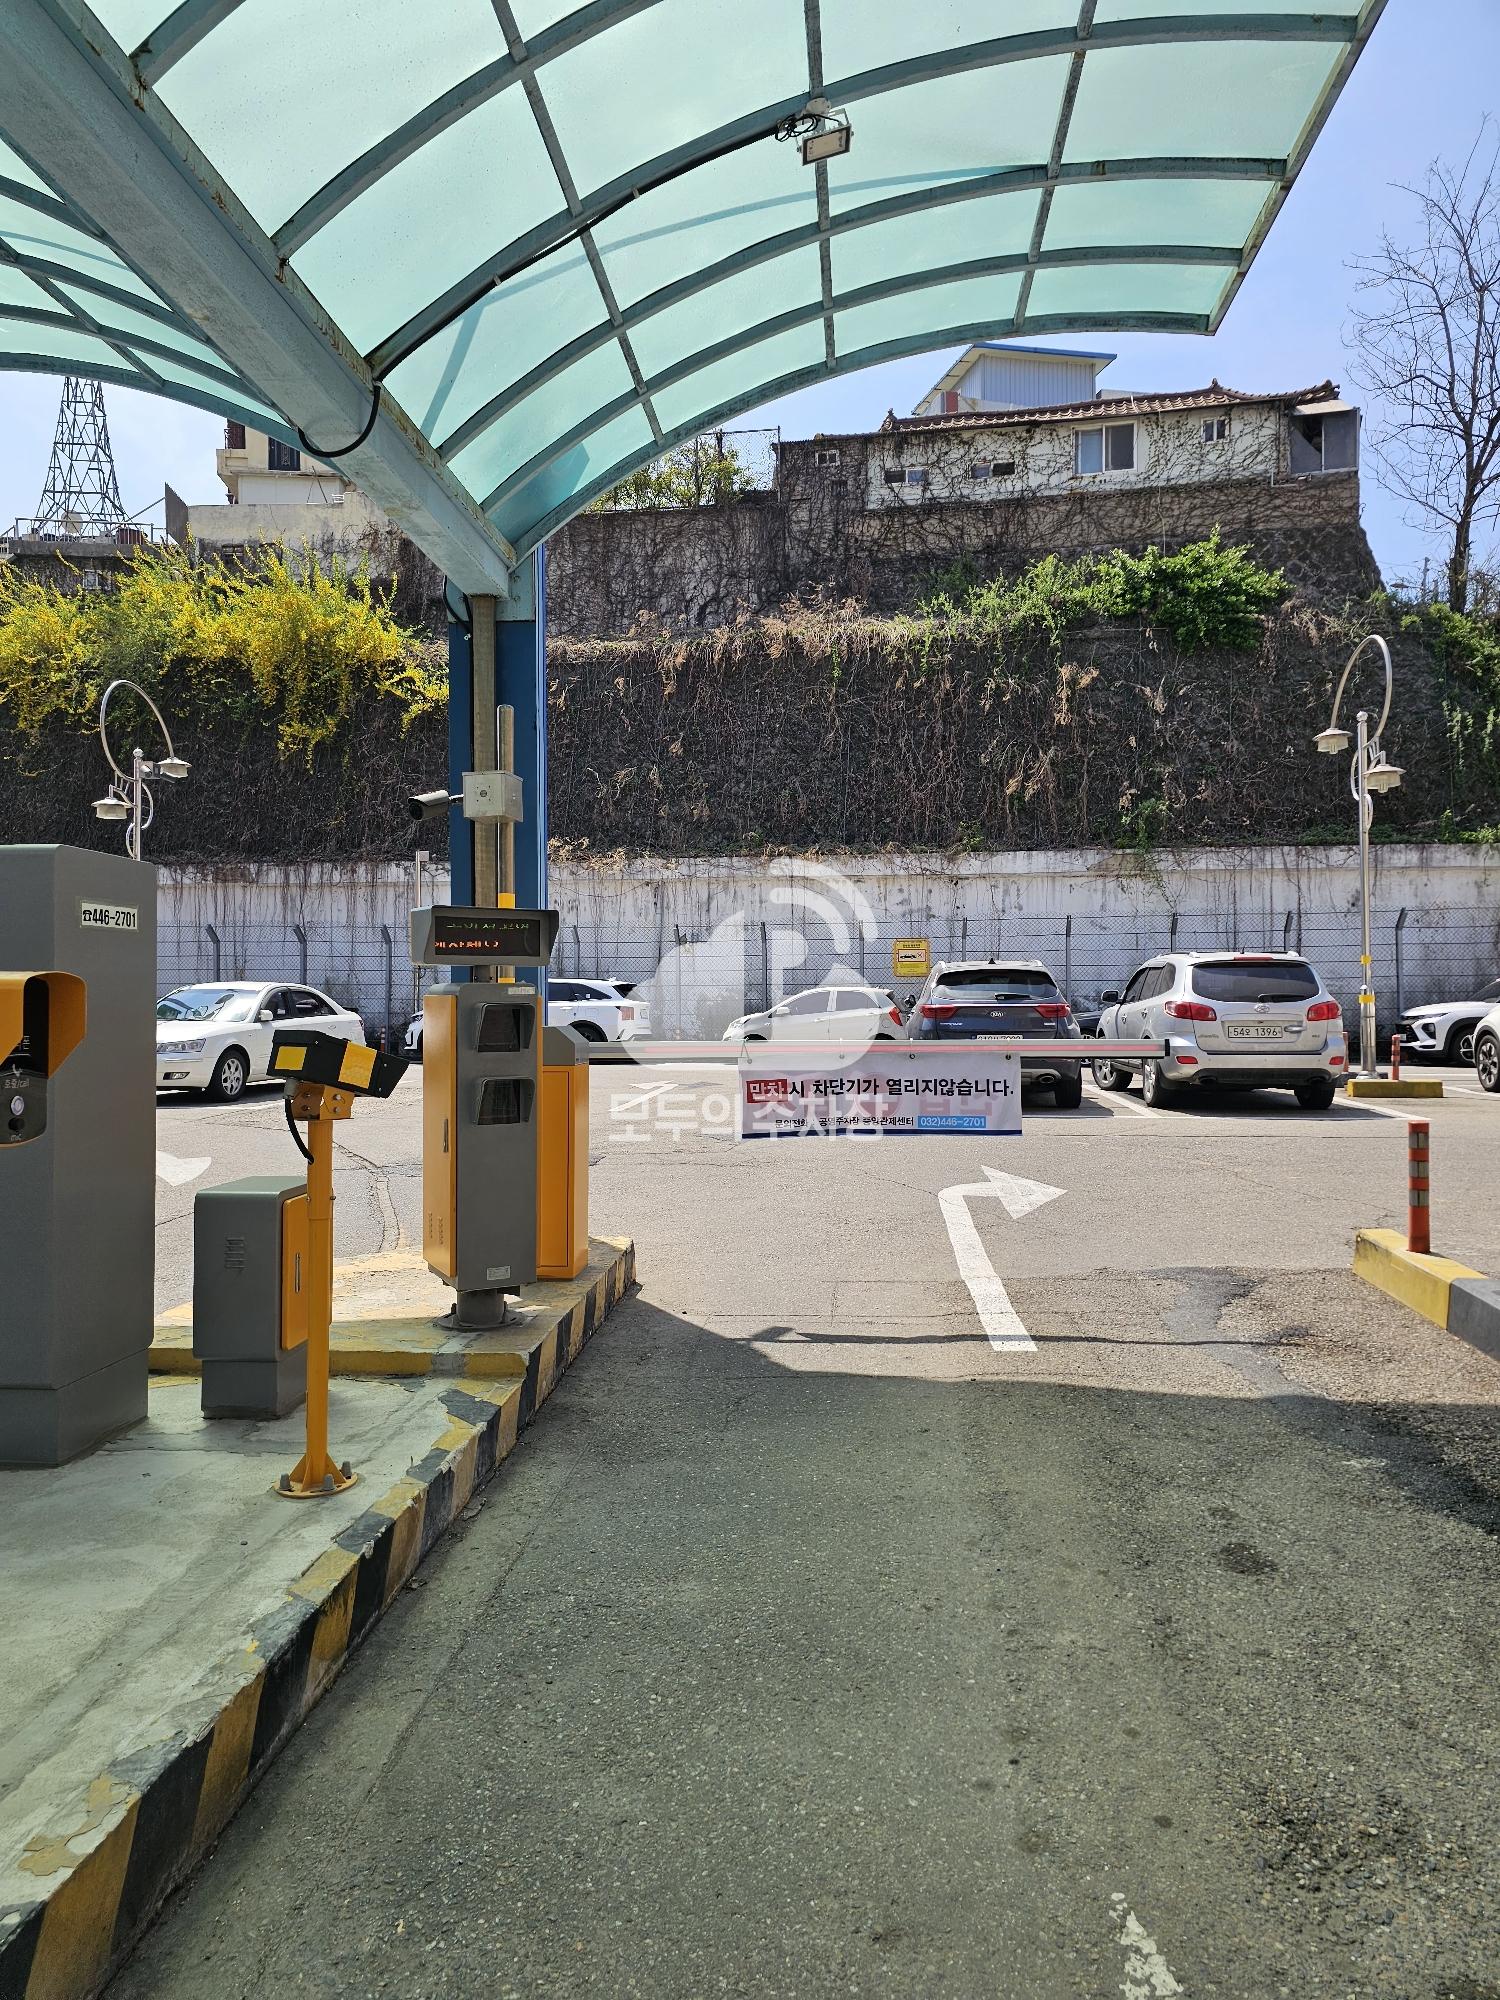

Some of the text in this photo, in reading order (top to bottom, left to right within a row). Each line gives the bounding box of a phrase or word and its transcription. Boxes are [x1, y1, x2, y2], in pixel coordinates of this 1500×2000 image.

[1255, 1027, 1278, 1036] 1396
[812, 1078, 879, 1097] 차단기가
[886, 1078, 1014, 1097] 열리지않습니다.
[920, 1117, 985, 1127] 032)446-2701
